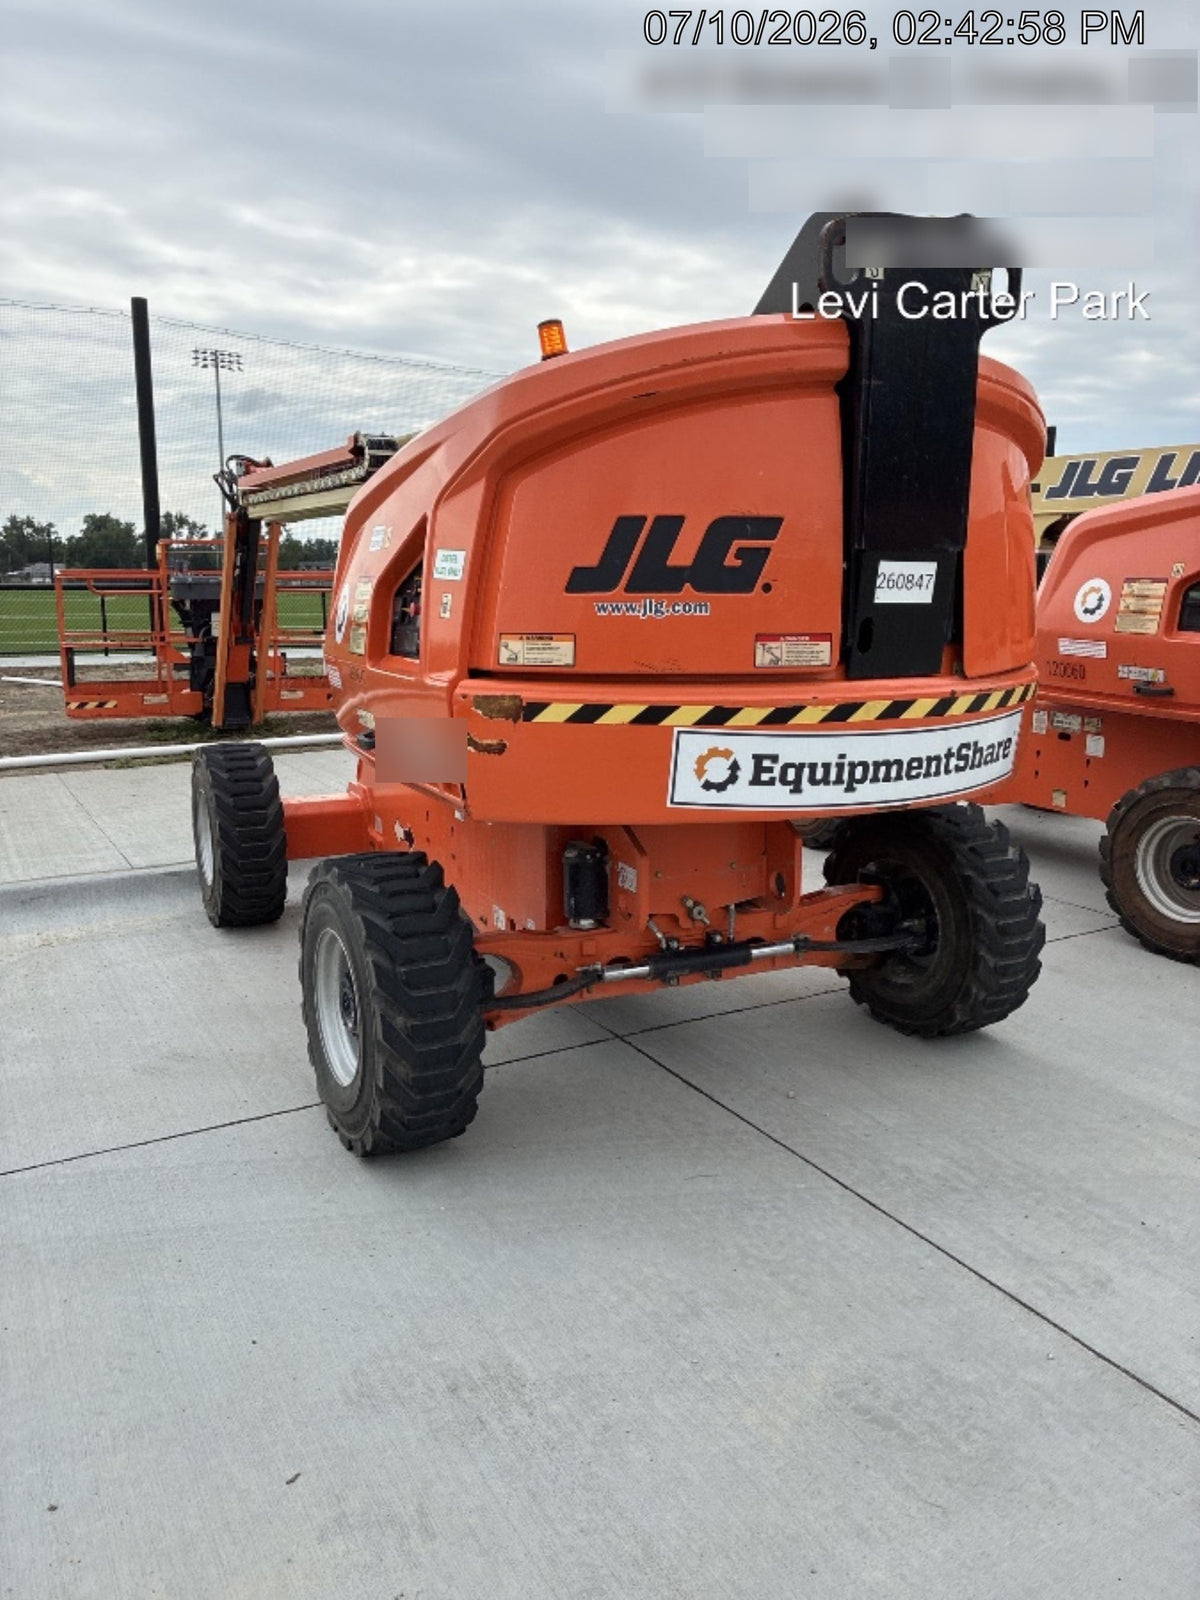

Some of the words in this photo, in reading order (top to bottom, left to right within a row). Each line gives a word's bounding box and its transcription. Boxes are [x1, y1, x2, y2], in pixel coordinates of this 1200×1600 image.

[1043, 455, 1142, 501] JLG
[876, 572, 934, 591] 260847
[594, 600, 711, 619] www.jlg.com
[749, 737, 1012, 794] EquipmentShare
